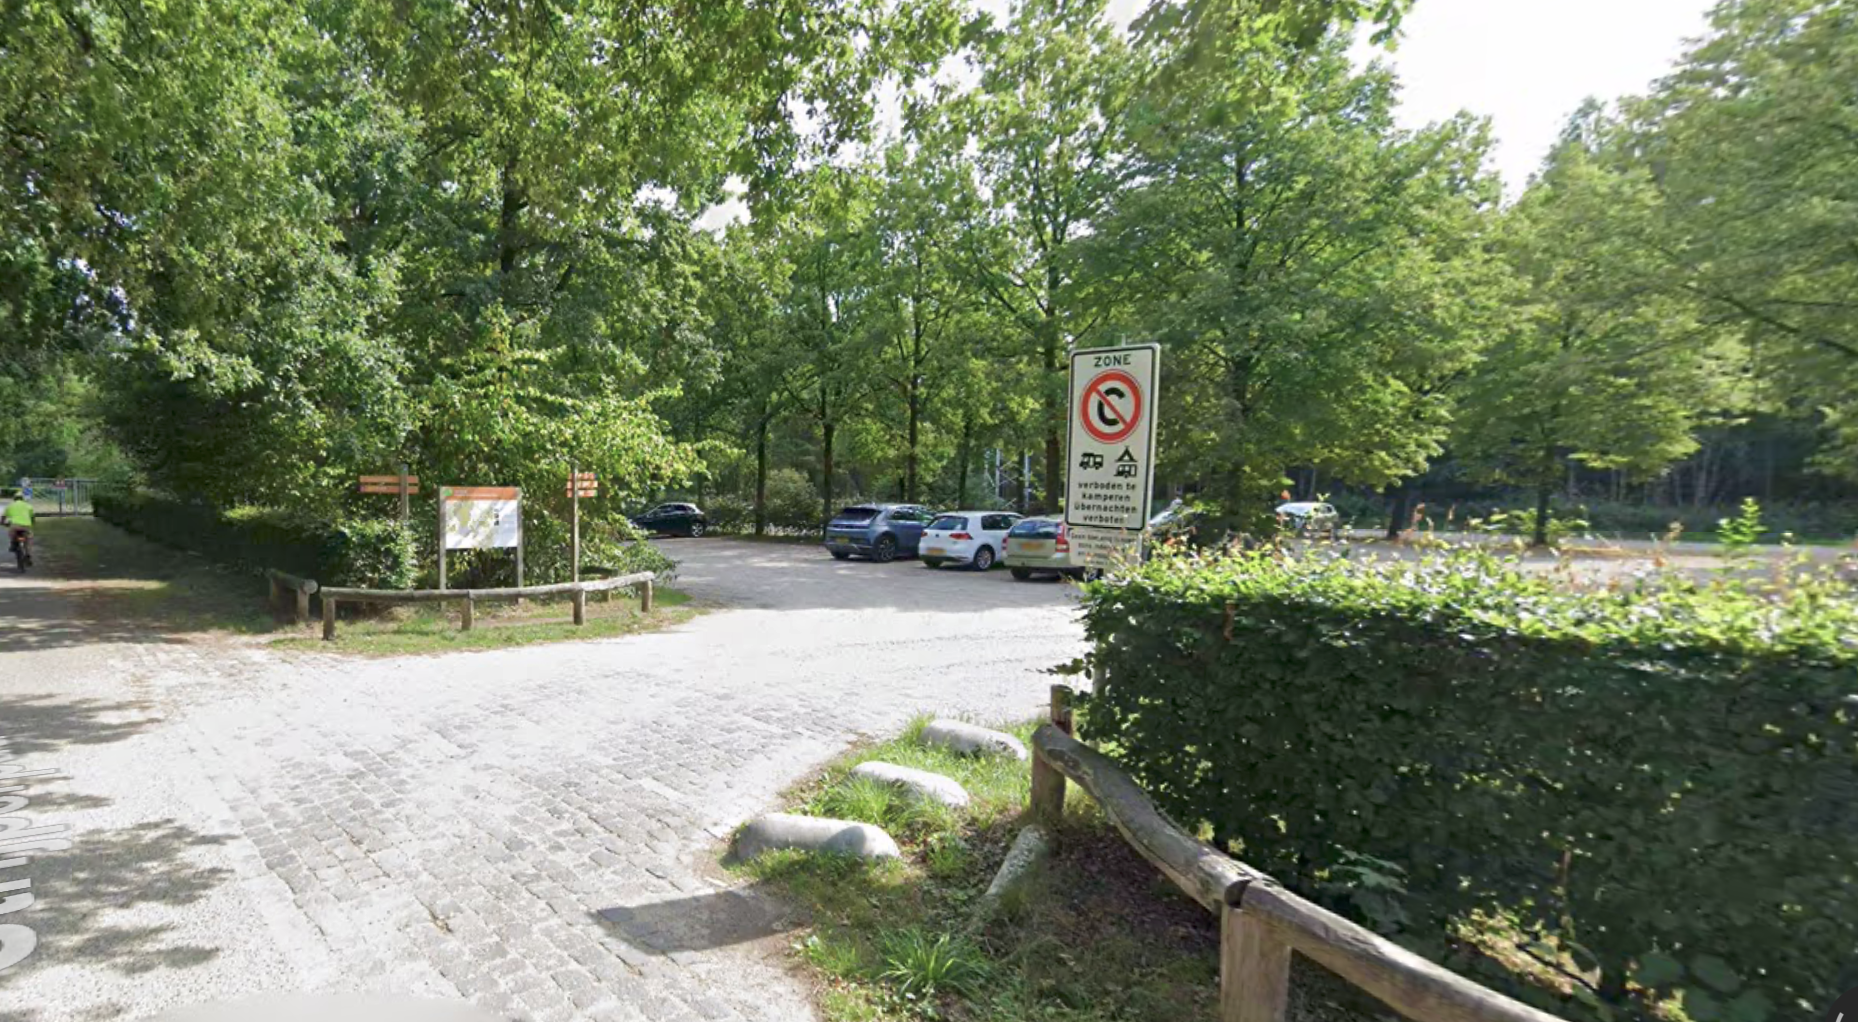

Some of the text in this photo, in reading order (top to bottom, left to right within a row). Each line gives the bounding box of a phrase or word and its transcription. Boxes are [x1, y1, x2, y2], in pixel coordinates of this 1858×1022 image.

[1094, 354, 1131, 367] ZONE
[1078, 482, 1136, 491] verboden te
[1082, 493, 1131, 501] kamperen
[1083, 514, 1124, 524] verboten
